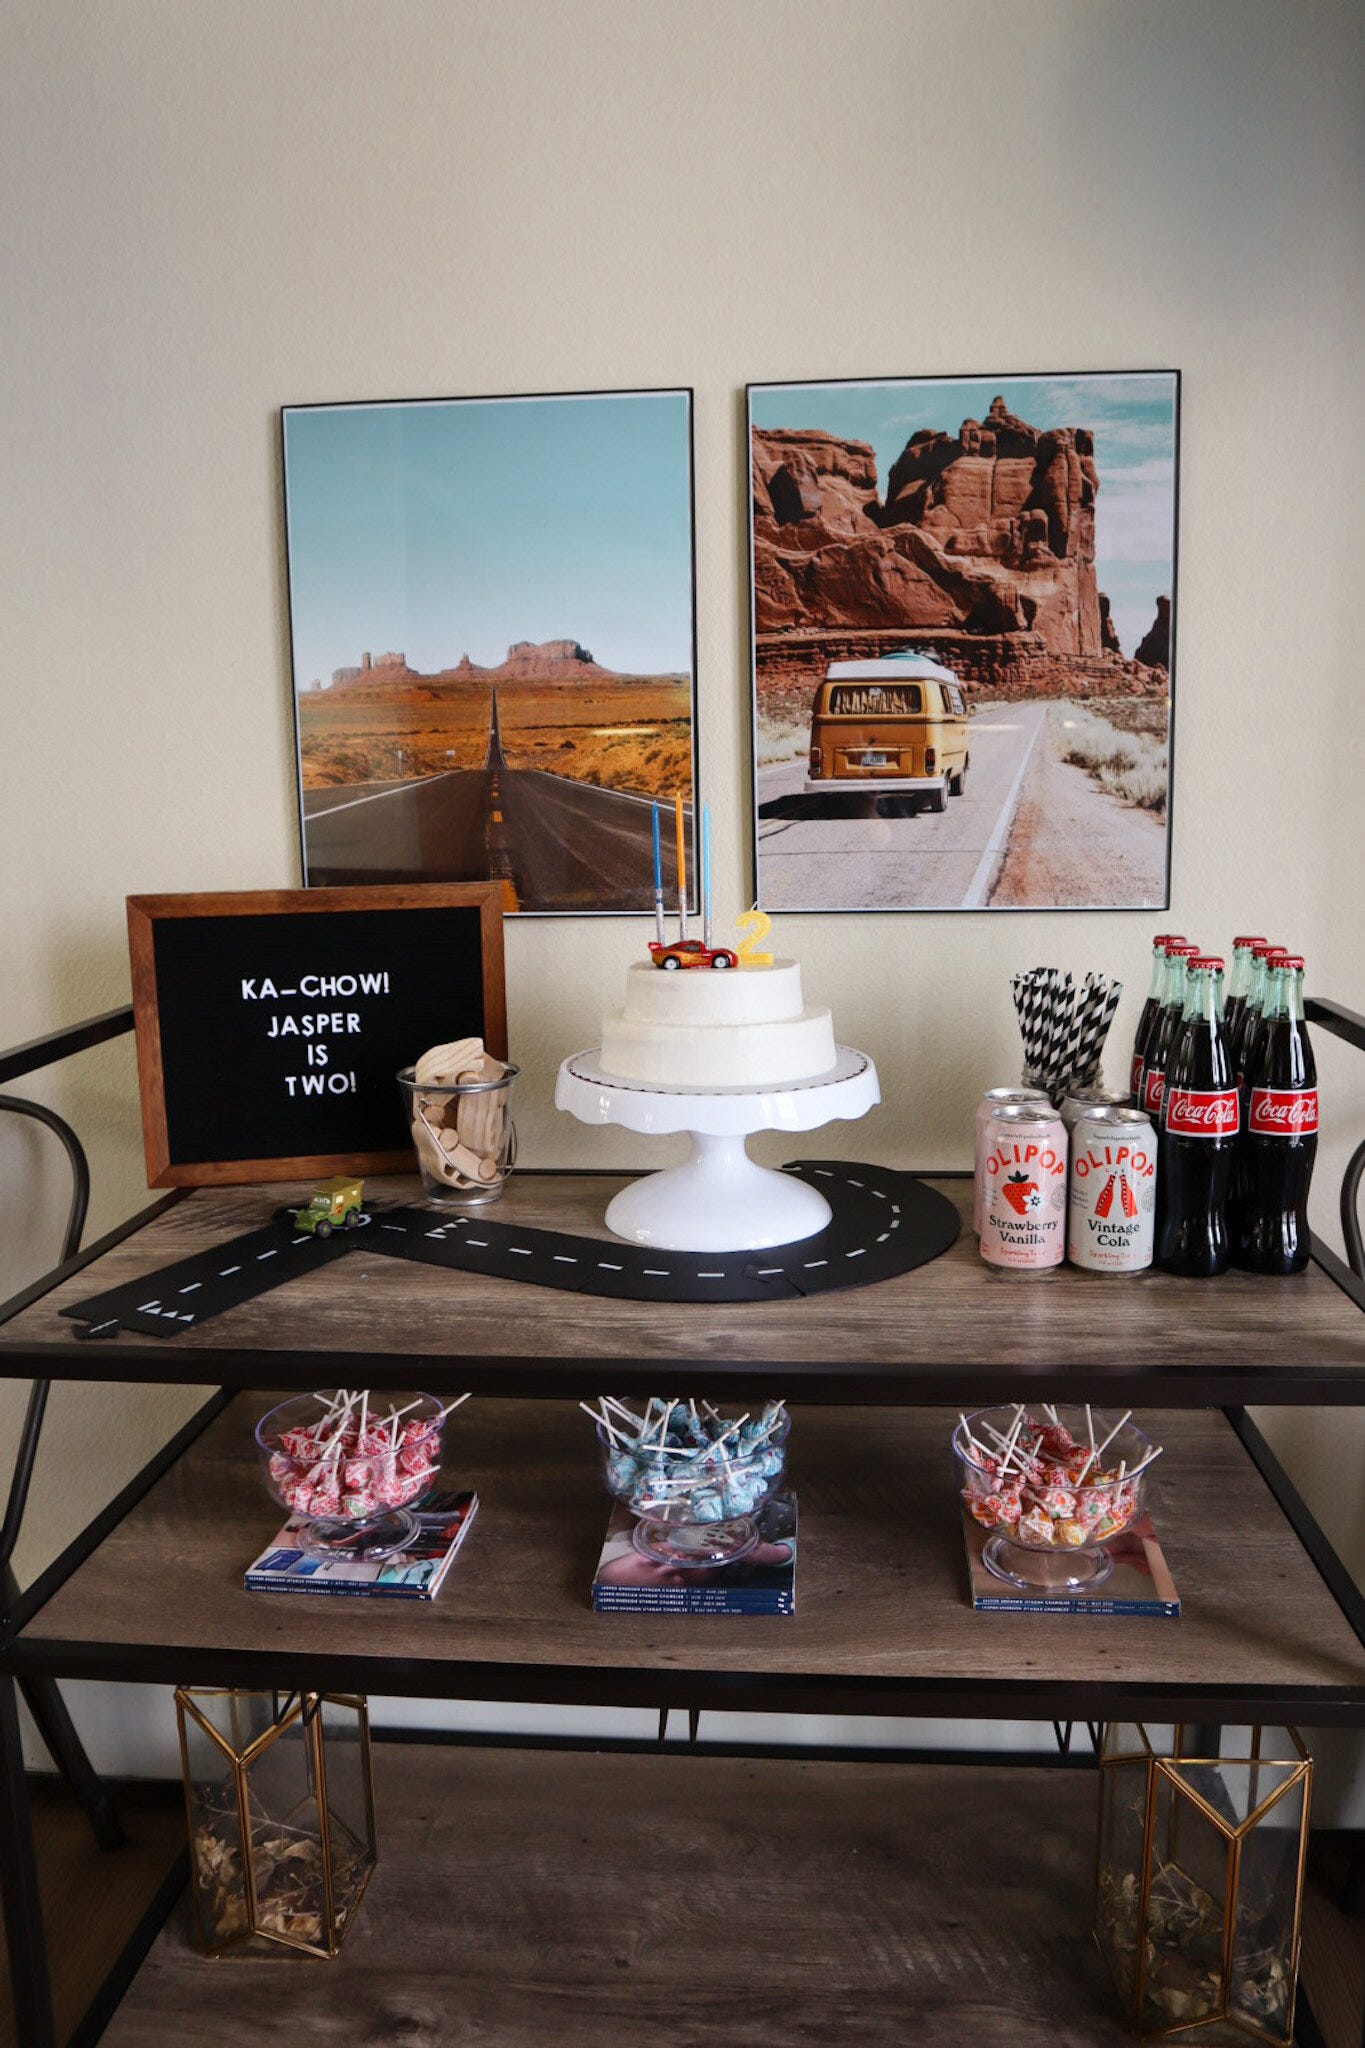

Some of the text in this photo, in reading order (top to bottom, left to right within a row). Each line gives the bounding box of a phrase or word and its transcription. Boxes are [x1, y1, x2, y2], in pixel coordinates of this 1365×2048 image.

[735, 910, 775, 966] 2
[241, 971, 390, 1000] KA-CHOW!
[267, 1012, 361, 1038] JASPER
[307, 1044, 329, 1067] IS
[285, 1071, 357, 1096] TWO!
[1171, 1098, 1236, 1125] Coca-Cola
[1255, 1097, 1317, 1124] Coca-Cola
[986, 1144, 1065, 1176] OLIPOP
[1075, 1146, 1154, 1178] OLIPOP
[989, 1214, 1058, 1231] Strawberry
[1087, 1218, 1140, 1235] Vintage
[1000, 1231, 1046, 1245] Vanilla
[1097, 1235, 1131, 1247] Cola
